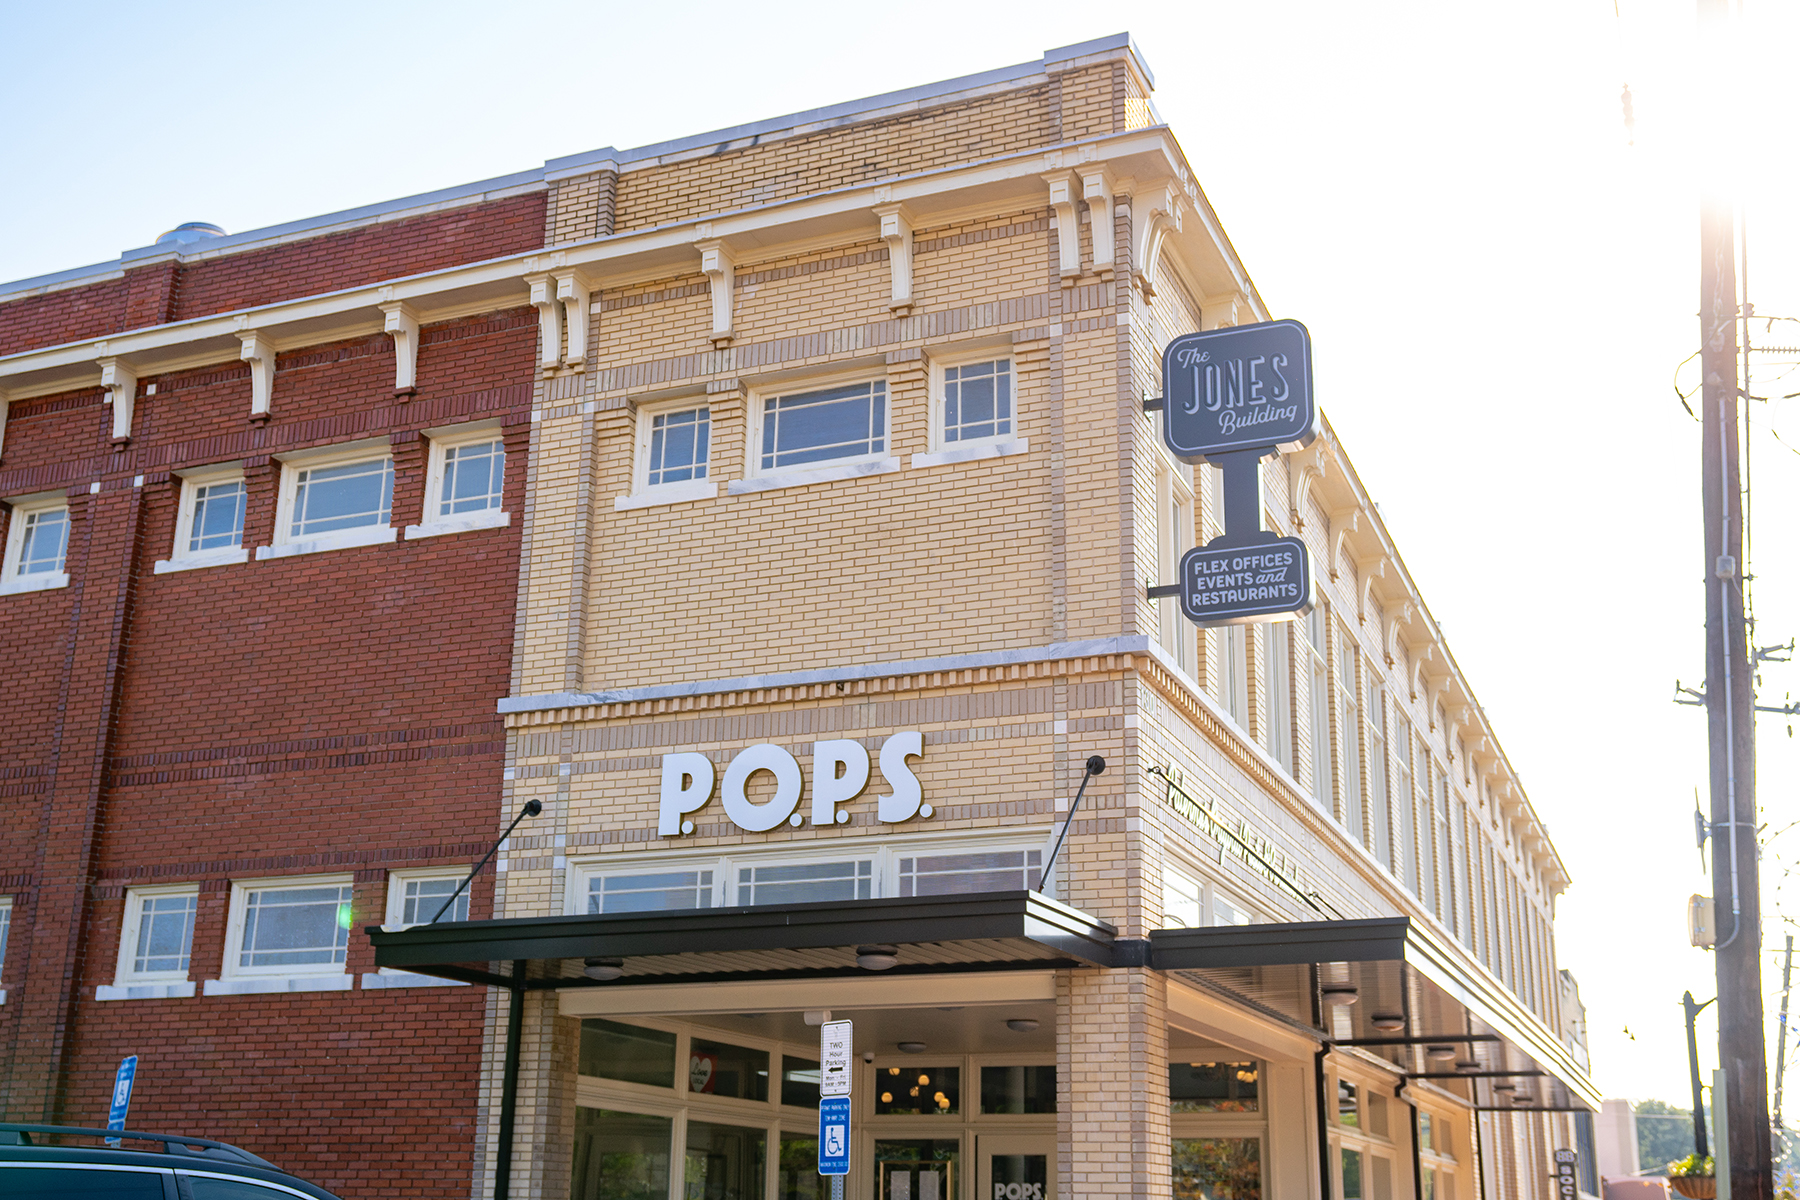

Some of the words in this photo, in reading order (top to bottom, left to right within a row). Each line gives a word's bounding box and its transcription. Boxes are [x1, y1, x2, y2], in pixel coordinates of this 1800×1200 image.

[1177, 347, 1211, 369] The
[1181, 352, 1289, 414] JONES
[1218, 403, 1298, 436] Building
[1194, 558, 1229, 575] FLEX
[1232, 551, 1293, 569] OFFICES
[1197, 571, 1254, 590] EVENTS
[1255, 566, 1287, 585] and
[1192, 583, 1298, 607] RESTAURANTS
[658, 730, 936, 837] P.O.P.S.
